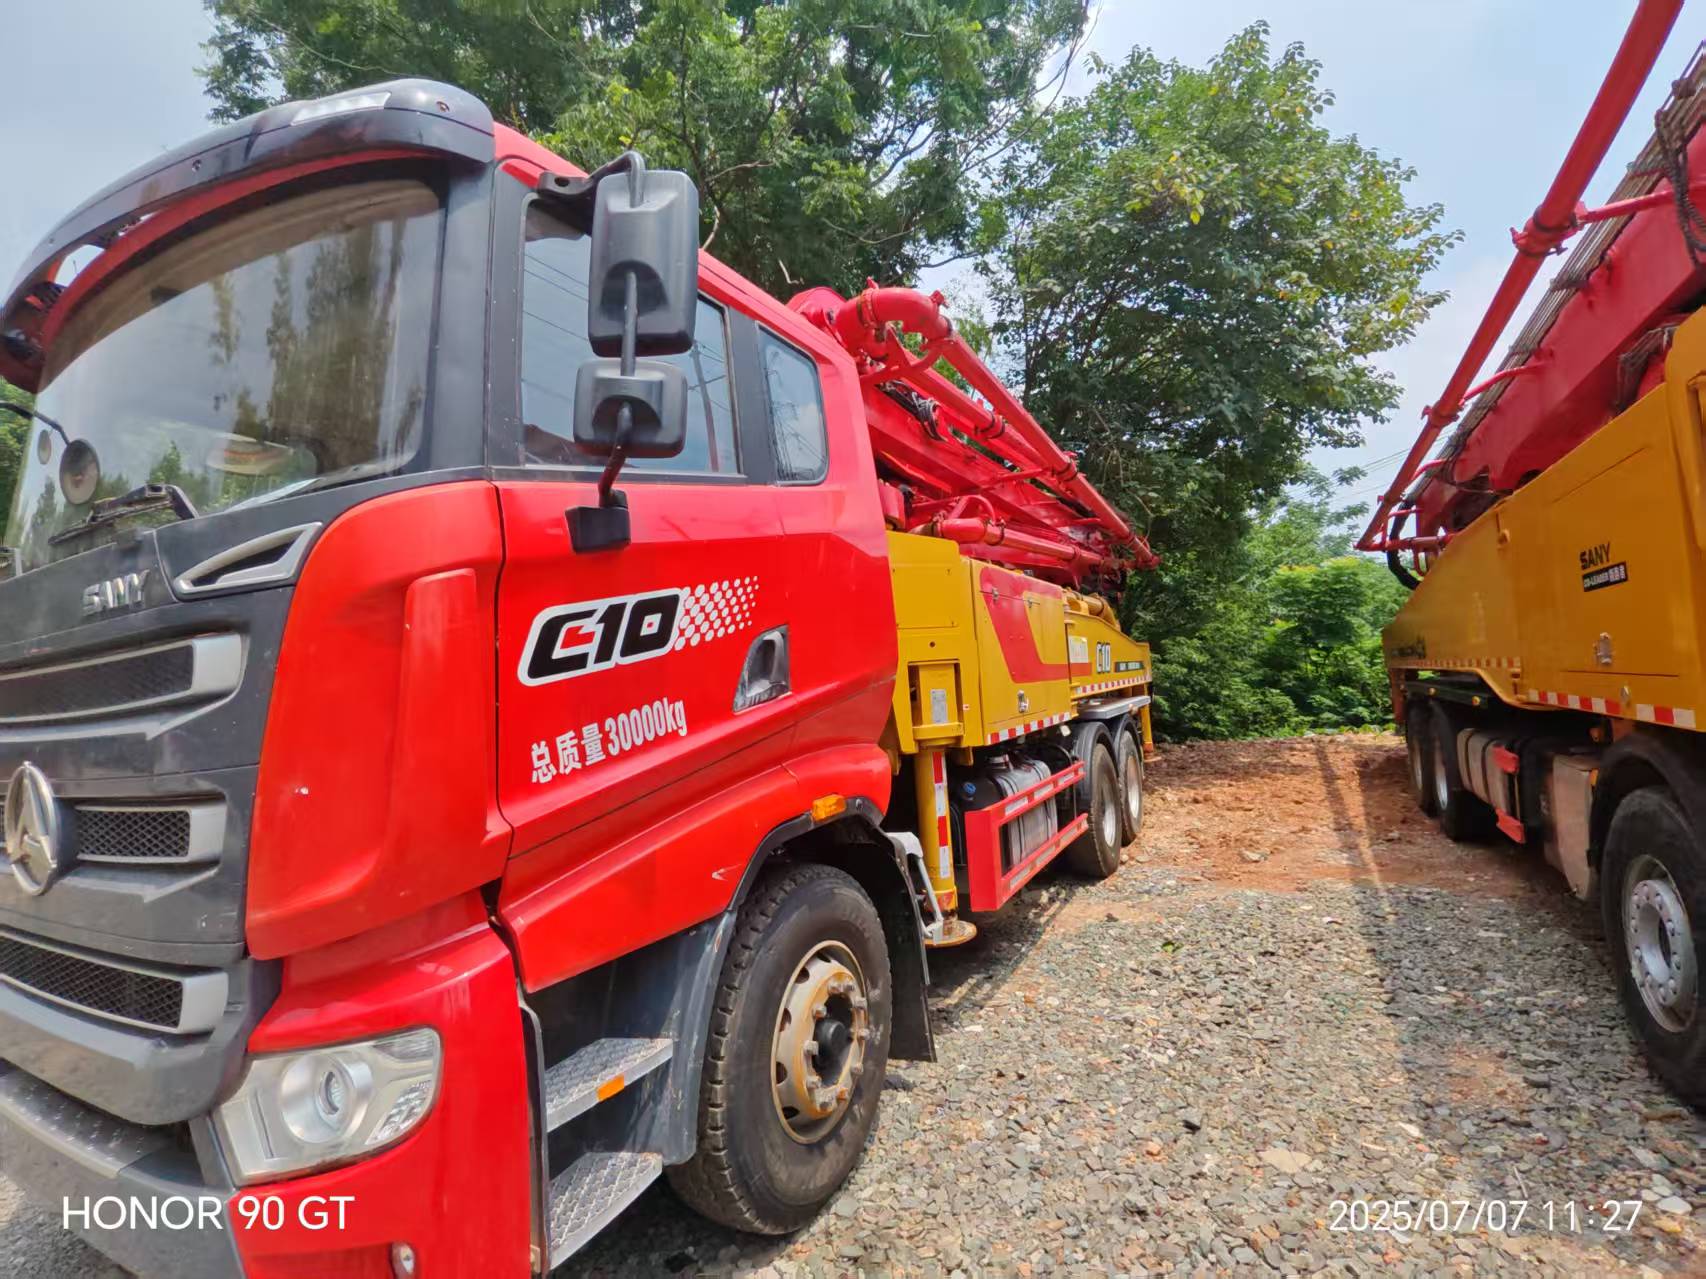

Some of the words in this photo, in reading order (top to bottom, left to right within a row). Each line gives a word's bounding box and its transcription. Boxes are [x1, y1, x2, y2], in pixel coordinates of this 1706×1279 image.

[1580, 541, 1610, 570] SANY
[83, 570, 149, 616] SANY
[521, 589, 682, 683] C10
